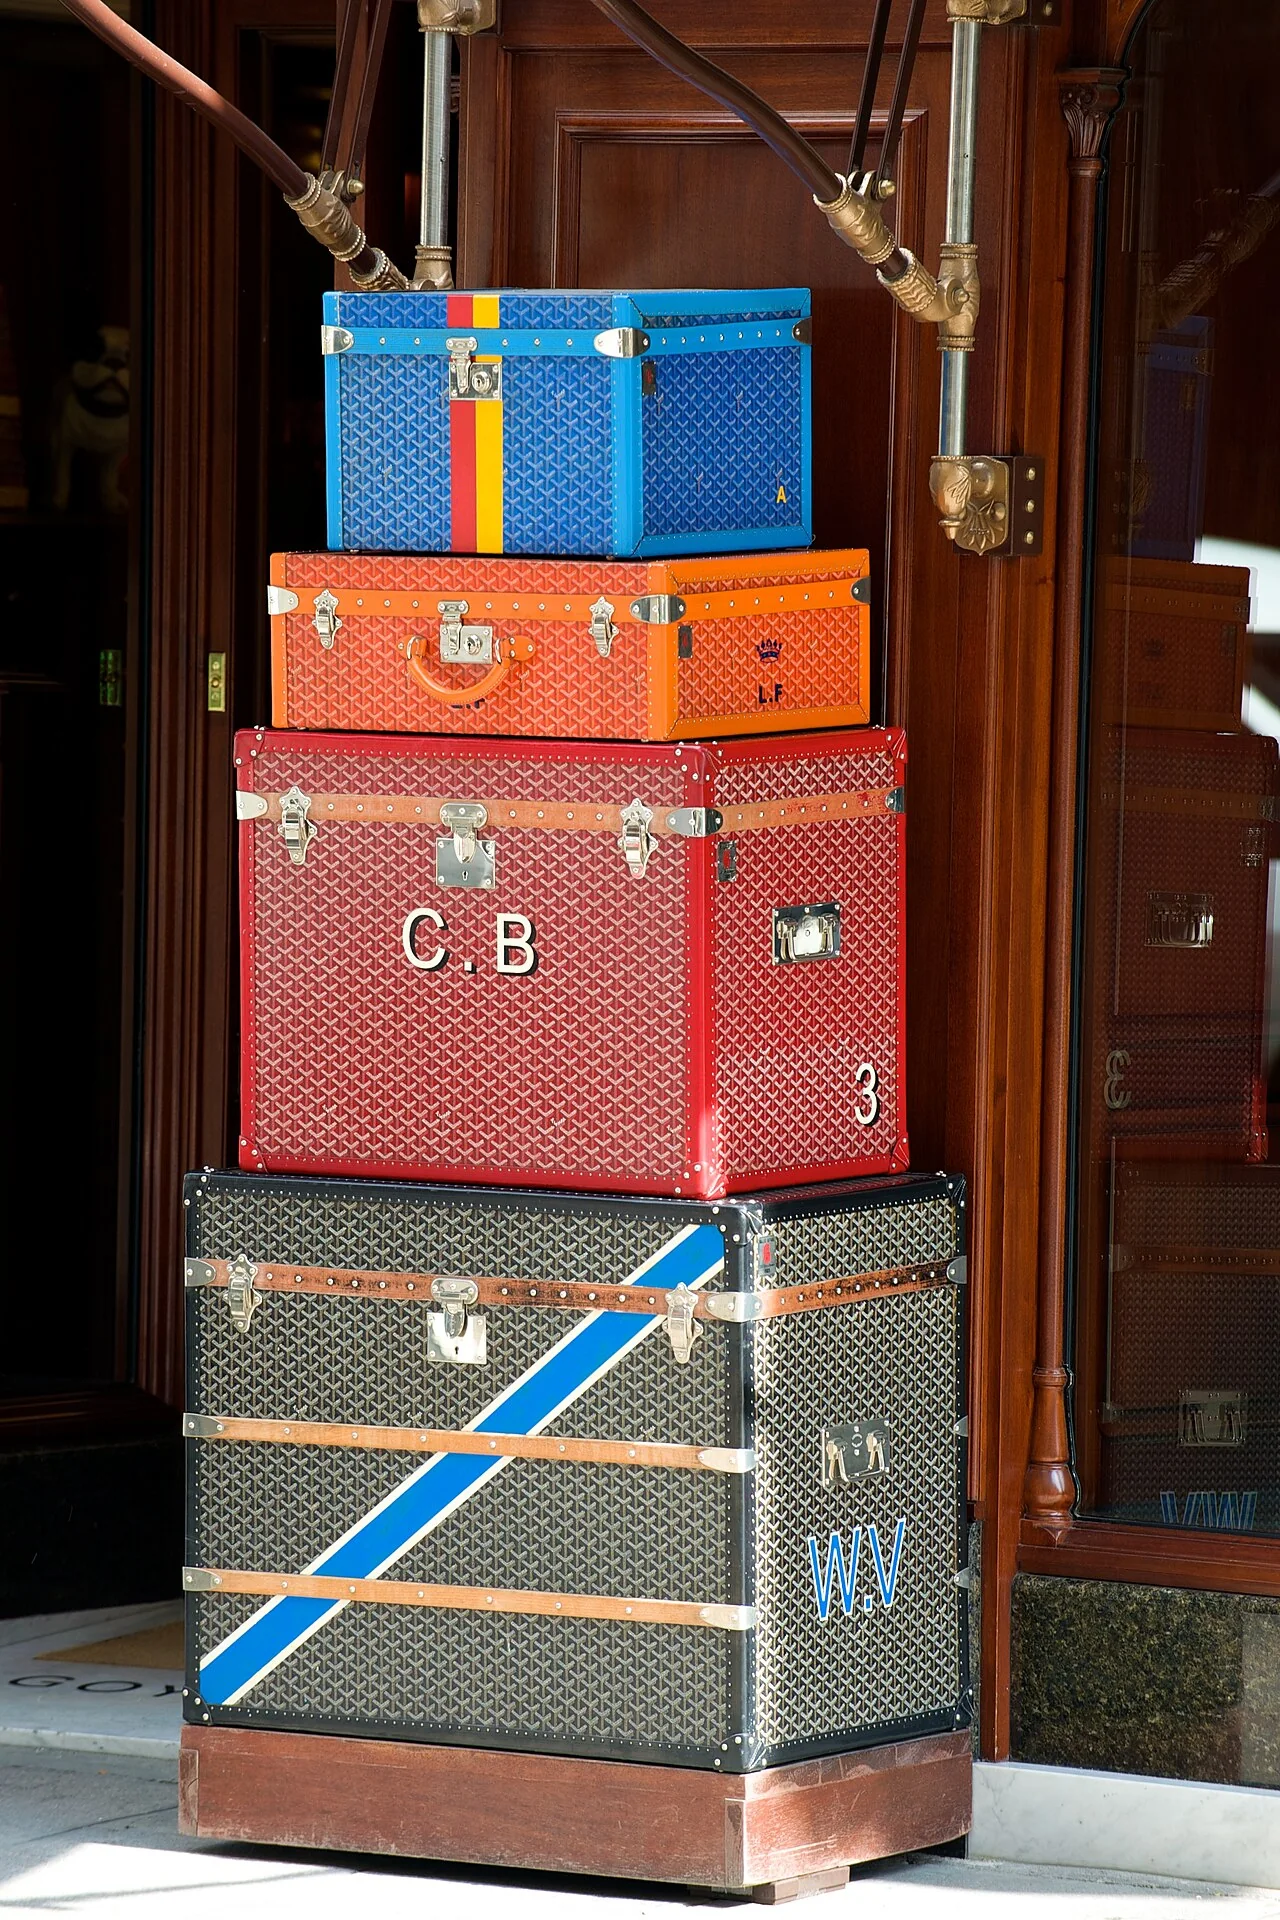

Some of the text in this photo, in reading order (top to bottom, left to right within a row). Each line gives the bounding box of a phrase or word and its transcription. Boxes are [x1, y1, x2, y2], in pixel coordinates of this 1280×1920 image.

[776, 485, 787, 503] A
[758, 683, 783, 704] L.F
[854, 1062, 879, 1127] 3
[806, 1516, 907, 1621] W.V
